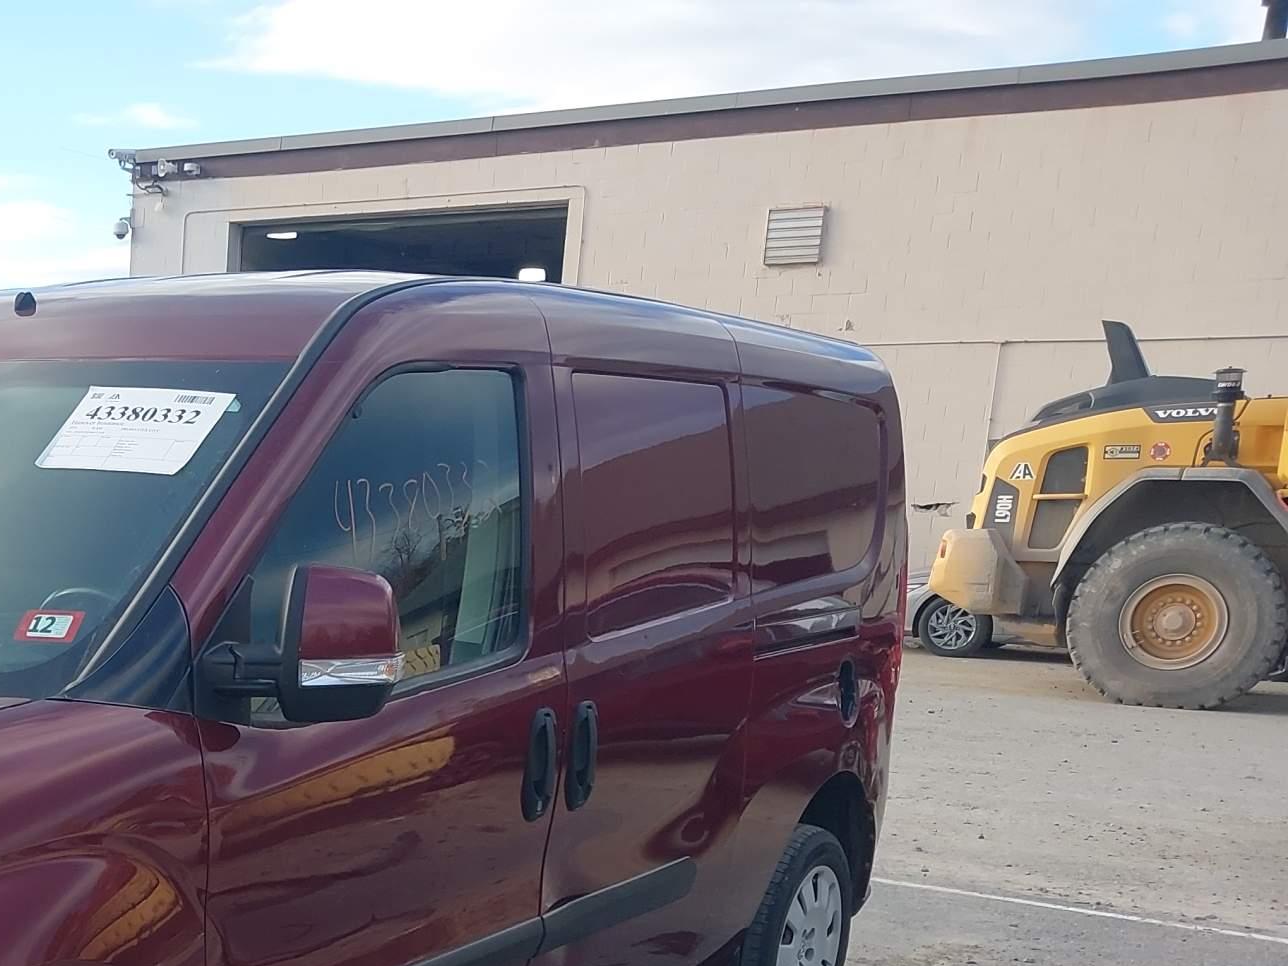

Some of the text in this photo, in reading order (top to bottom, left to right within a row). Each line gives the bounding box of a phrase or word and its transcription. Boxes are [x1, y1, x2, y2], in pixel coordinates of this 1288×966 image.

[85, 405, 201, 425] 43380332
[994, 495, 1014, 523] L90H
[28, 616, 56, 633] 12
